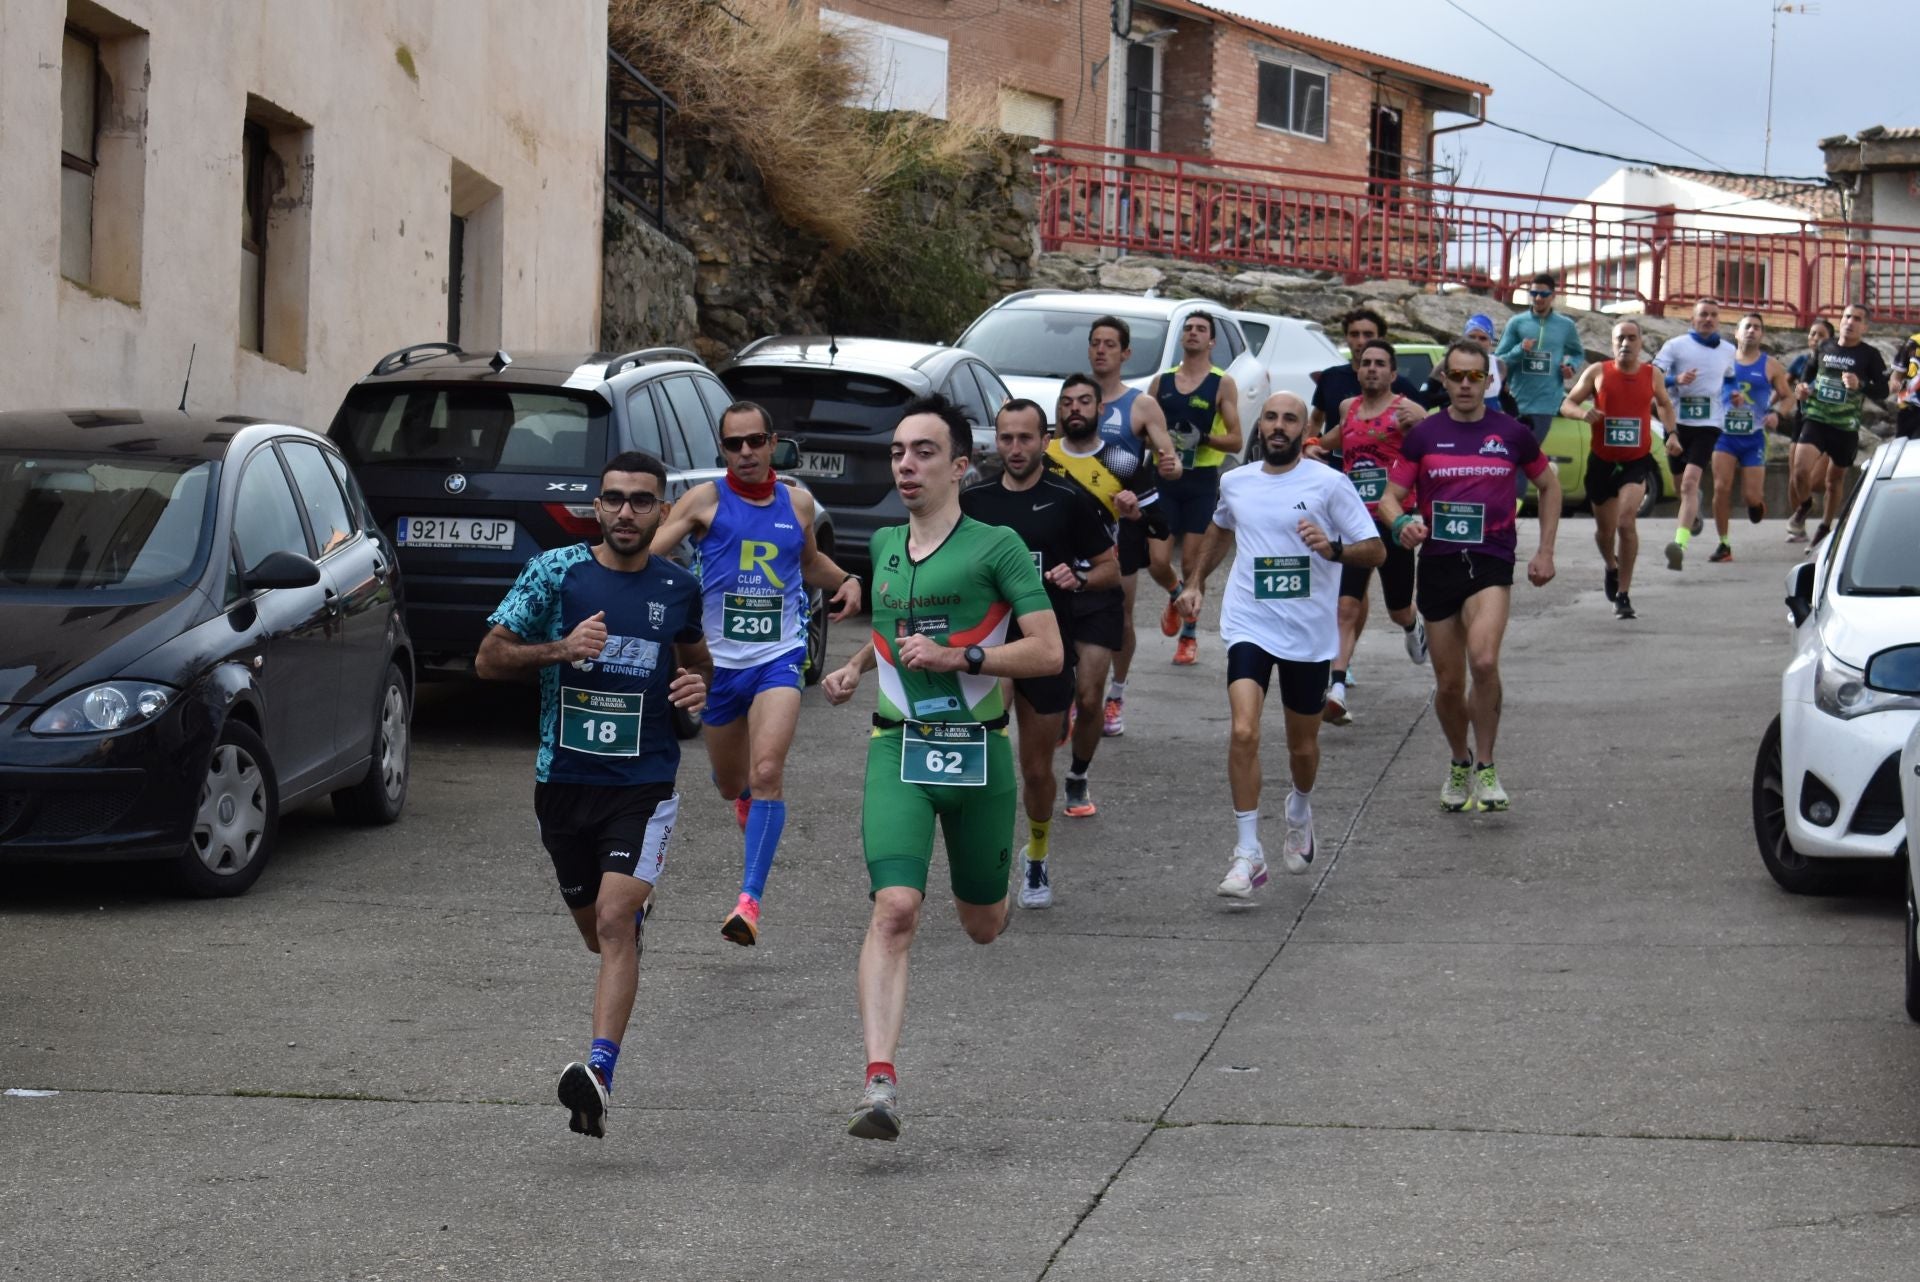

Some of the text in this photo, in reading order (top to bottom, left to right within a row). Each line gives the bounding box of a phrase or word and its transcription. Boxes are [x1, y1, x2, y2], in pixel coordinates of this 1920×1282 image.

[1822, 388, 1841, 399] 123
[1688, 407, 1702, 416] 13
[1728, 421, 1748, 430] 147
[1610, 430, 1634, 441] 153
[809, 454, 840, 471] KMN
[1438, 466, 1511, 477] INTERSPORT
[545, 482, 588, 491] X3
[1359, 484, 1377, 496] 45
[412, 520, 508, 541] 9214 GJP
[1446, 520, 1468, 535] 46
[739, 540, 785, 589] R
[737, 574, 762, 584] CLUB
[1263, 575, 1301, 592] 128
[737, 586, 777, 596] MARATÓN
[882, 592, 961, 610] CataNatura
[731, 616, 773, 634] 230
[603, 664, 651, 677] RUNNERS
[582, 719, 617, 743] 18
[926, 750, 962, 773] 62
